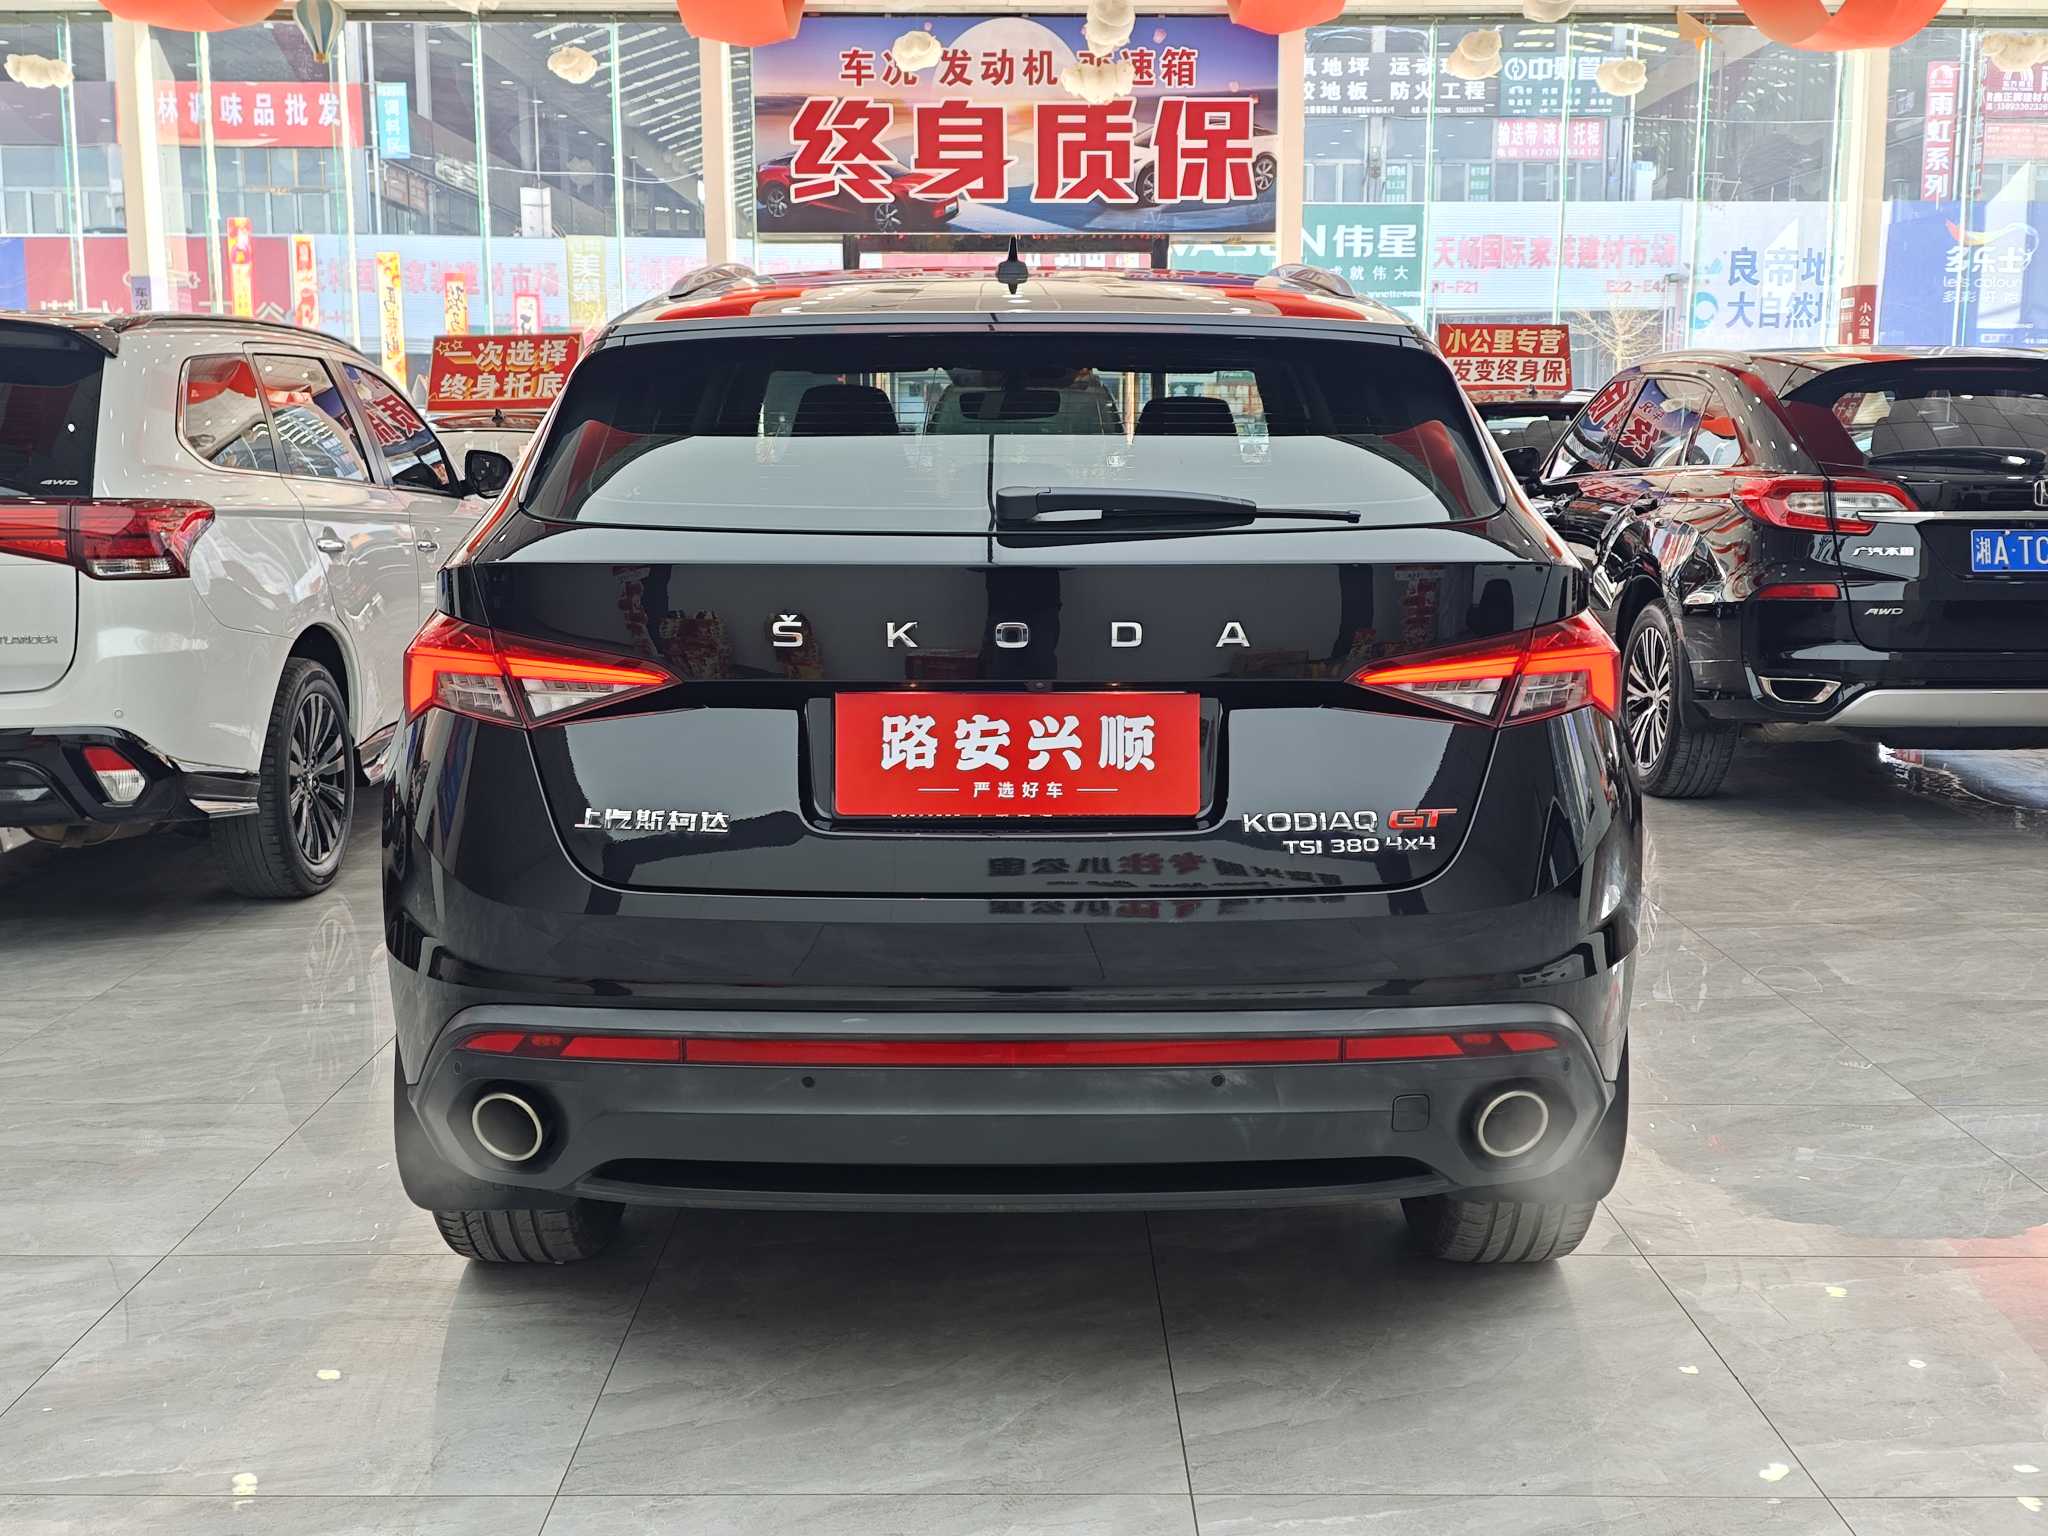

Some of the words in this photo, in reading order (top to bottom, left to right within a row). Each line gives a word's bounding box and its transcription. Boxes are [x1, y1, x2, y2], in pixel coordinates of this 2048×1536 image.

[940, 48, 1059, 87] 发动机
[790, 96, 1256, 204] 终身质保
[1332, 224, 1417, 258] 伟星
[444, 340, 568, 368] 一次选择
[1445, 329, 1562, 354] 小公里专营
[1453, 358, 1562, 383] 发变终身保
[438, 372, 562, 400] 终身托底
[880, 714, 1155, 772] 路安兴顺
[972, 782, 1064, 799] 严选好车
[574, 808, 730, 834] 上汽斯柯达
[1243, 811, 1378, 833] KODIAQ
[1388, 808, 1458, 830] GT
[1283, 840, 1323, 855] TSI
[1331, 839, 1380, 854] 380
[1386, 836, 1437, 852] 4x4
